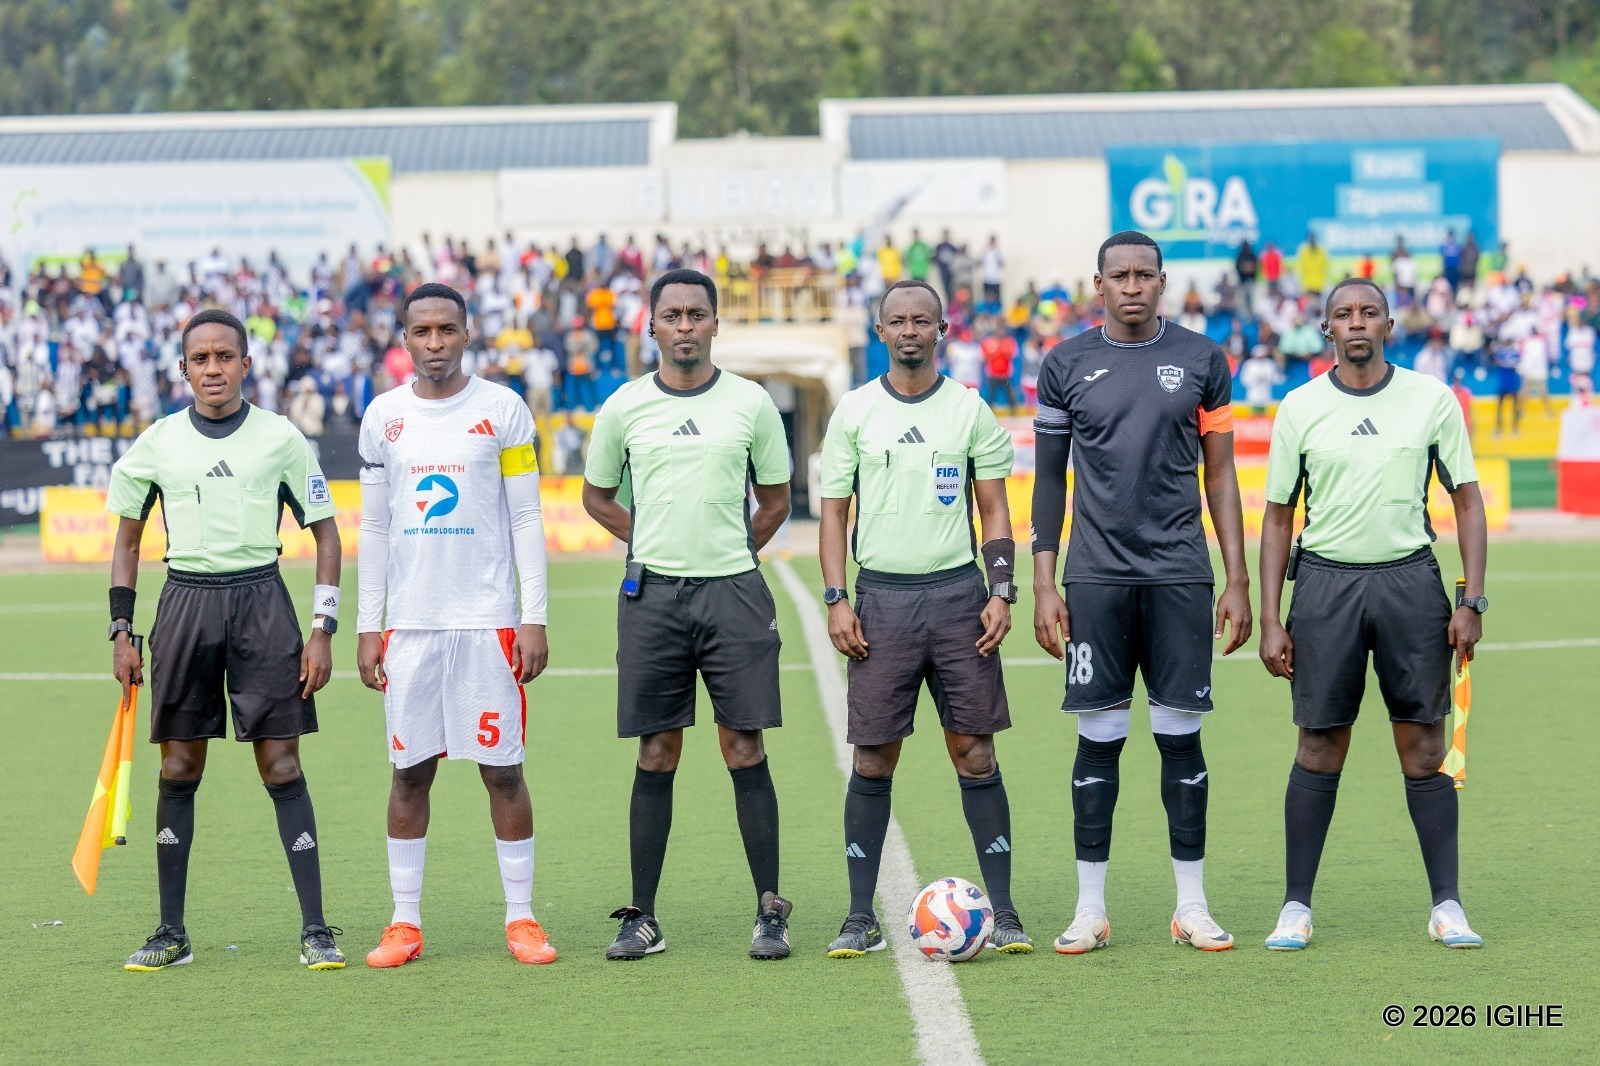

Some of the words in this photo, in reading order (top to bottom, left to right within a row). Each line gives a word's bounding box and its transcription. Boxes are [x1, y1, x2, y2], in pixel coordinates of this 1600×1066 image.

[41, 437, 113, 468] THE
[410, 465, 435, 474] SHIP
[437, 464, 465, 473] WITH
[936, 467, 959, 478] FIFA
[420, 527, 439, 535] YARD
[439, 527, 475, 535] LOGISTICS
[1067, 641, 1094, 686] 28
[477, 711, 501, 748] 5
